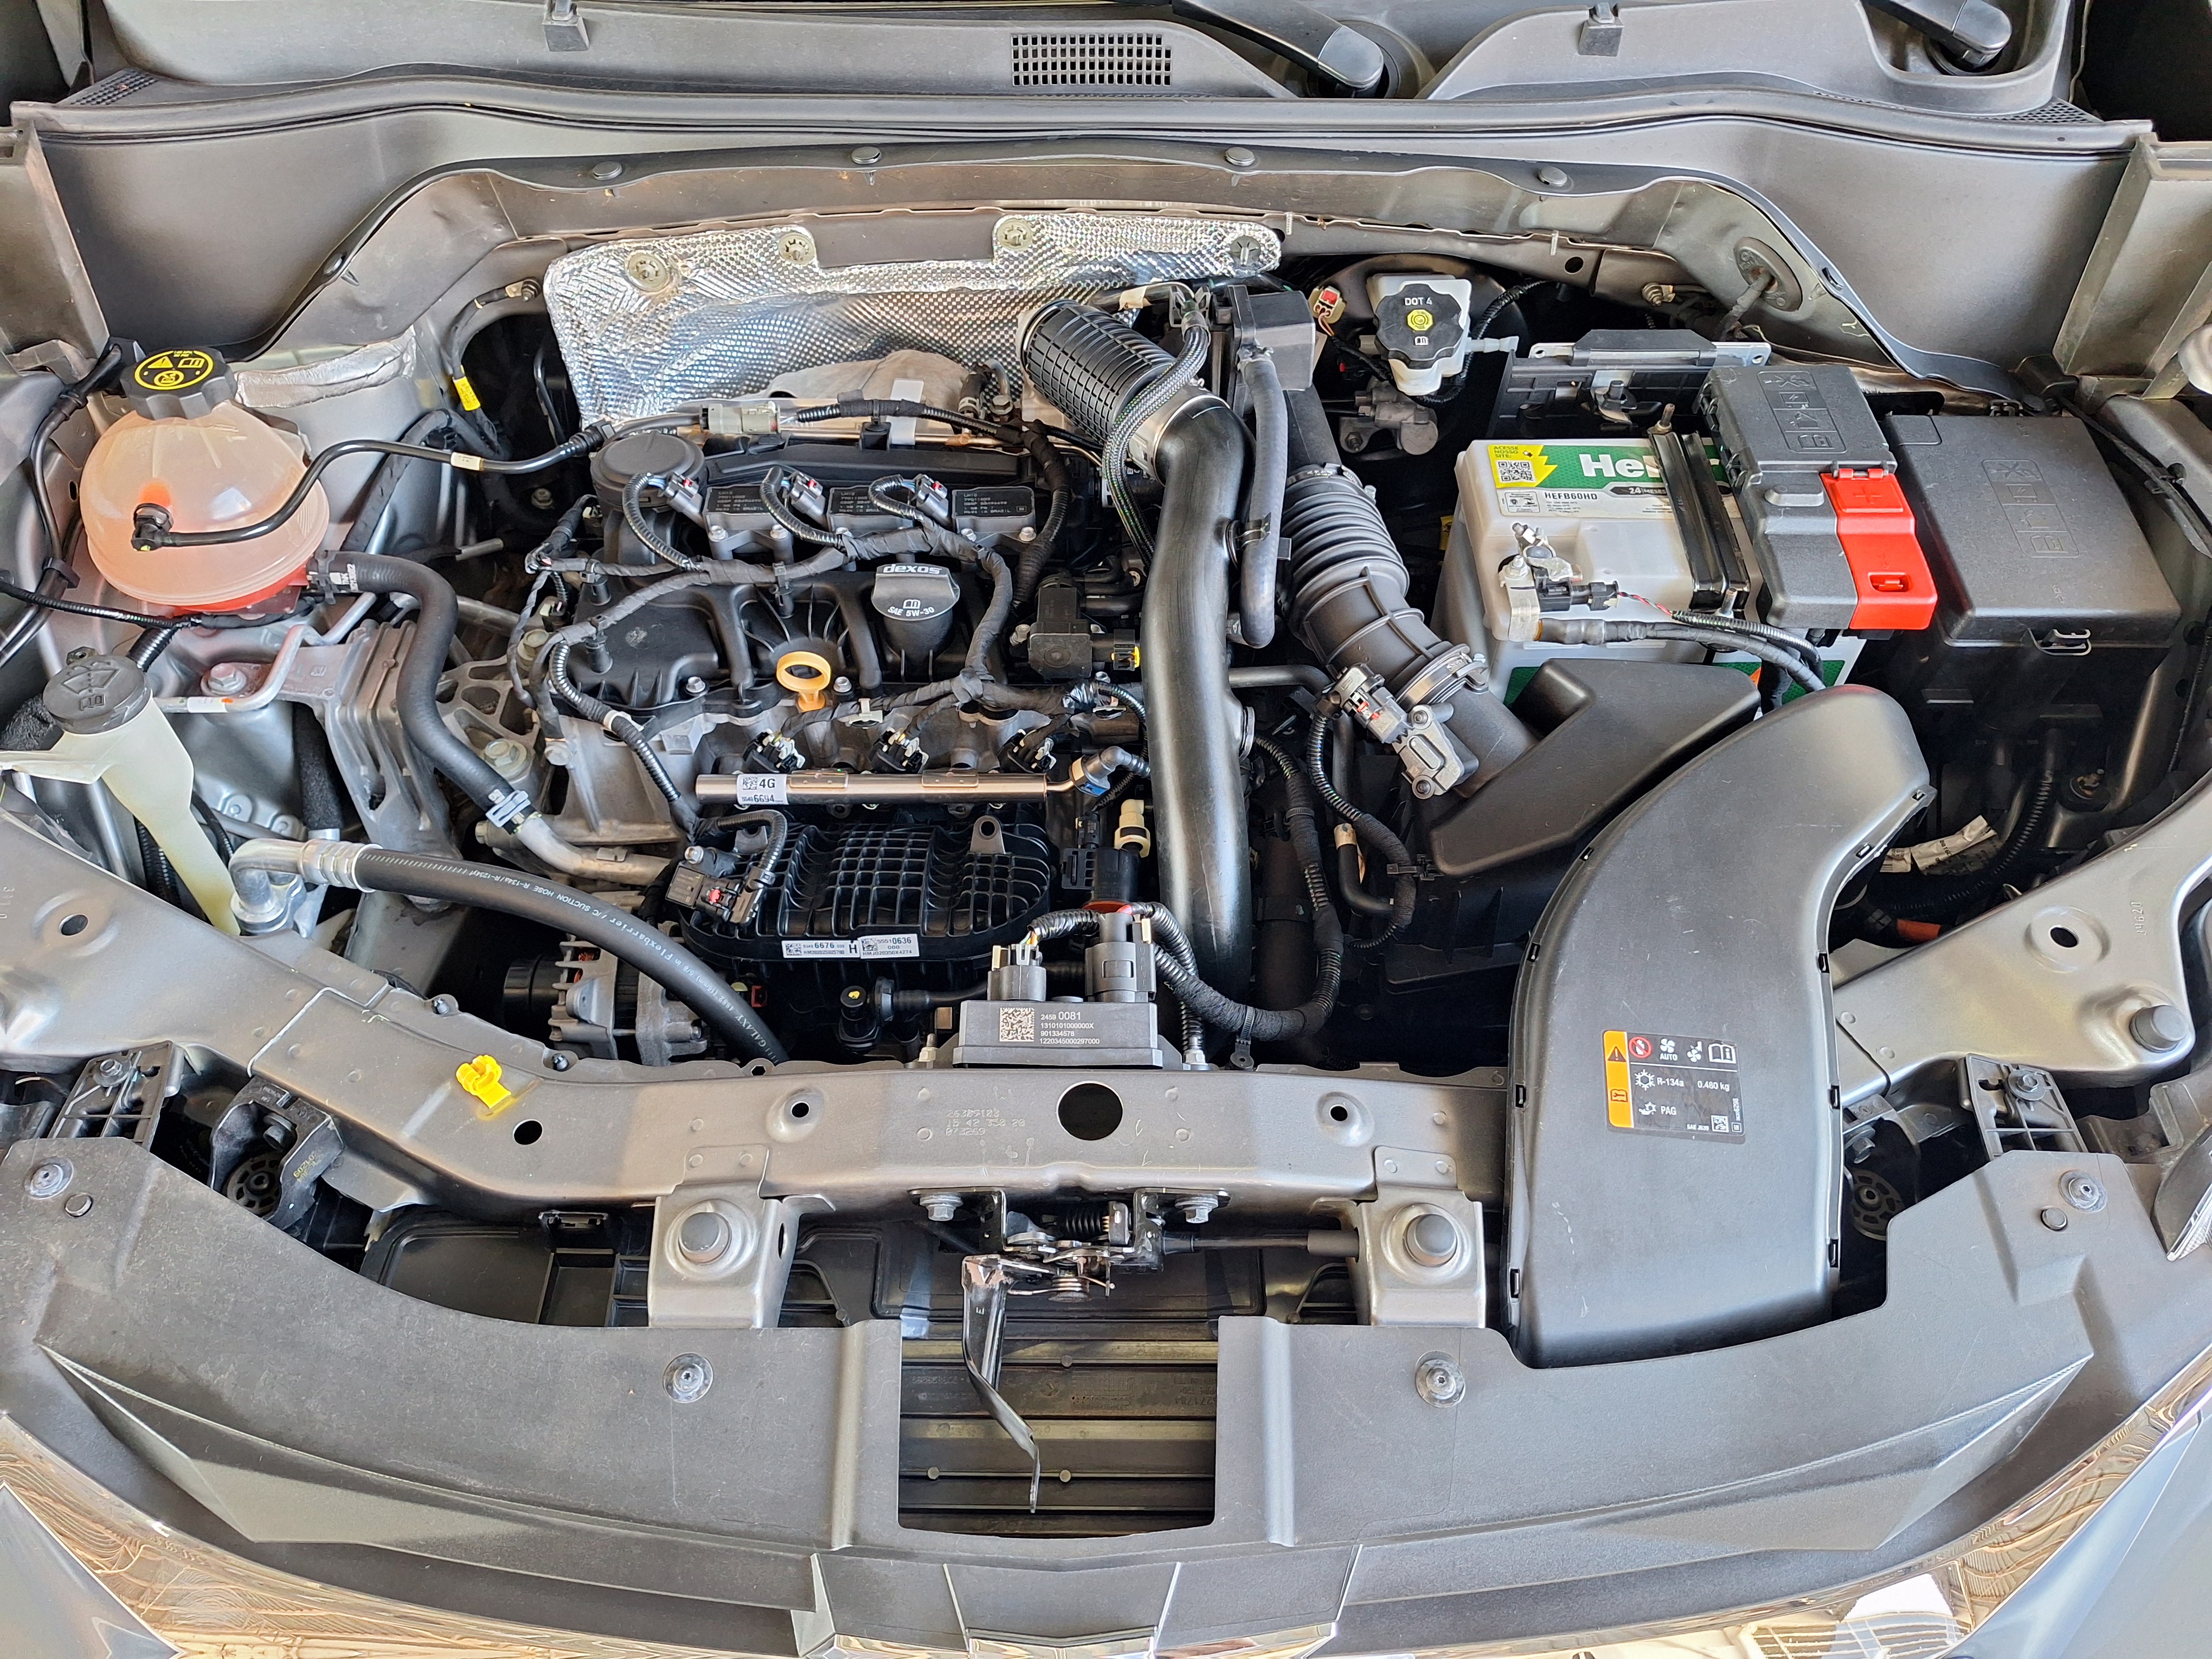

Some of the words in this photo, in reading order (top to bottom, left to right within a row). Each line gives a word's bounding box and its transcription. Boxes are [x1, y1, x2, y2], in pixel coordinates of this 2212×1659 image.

[883, 564, 943, 575] dexos
[888, 606, 903, 616] SAE
[905, 607, 935, 617] 5W-30
[759, 779, 775, 788] 4G
[532, 884, 555, 898] HOSE
[556, 893, 591, 912] SUCTION
[609, 916, 674, 962] Flexbarrier
[848, 944, 858, 954] H
[674, 958, 682, 967] in
[683, 964, 695, 977] 5/8
[696, 975, 718, 996] (16mm)
[719, 995, 735, 1012] 4882
[1058, 1012, 1081, 1020] 0081
[735, 1013, 767, 1048] GALAXY
[1657, 1077, 1684, 1087] R-134a
[1697, 1080, 1718, 1090] 0.480
[1720, 1082, 1730, 1092] kg
[1661, 1106, 1677, 1115] PAG
